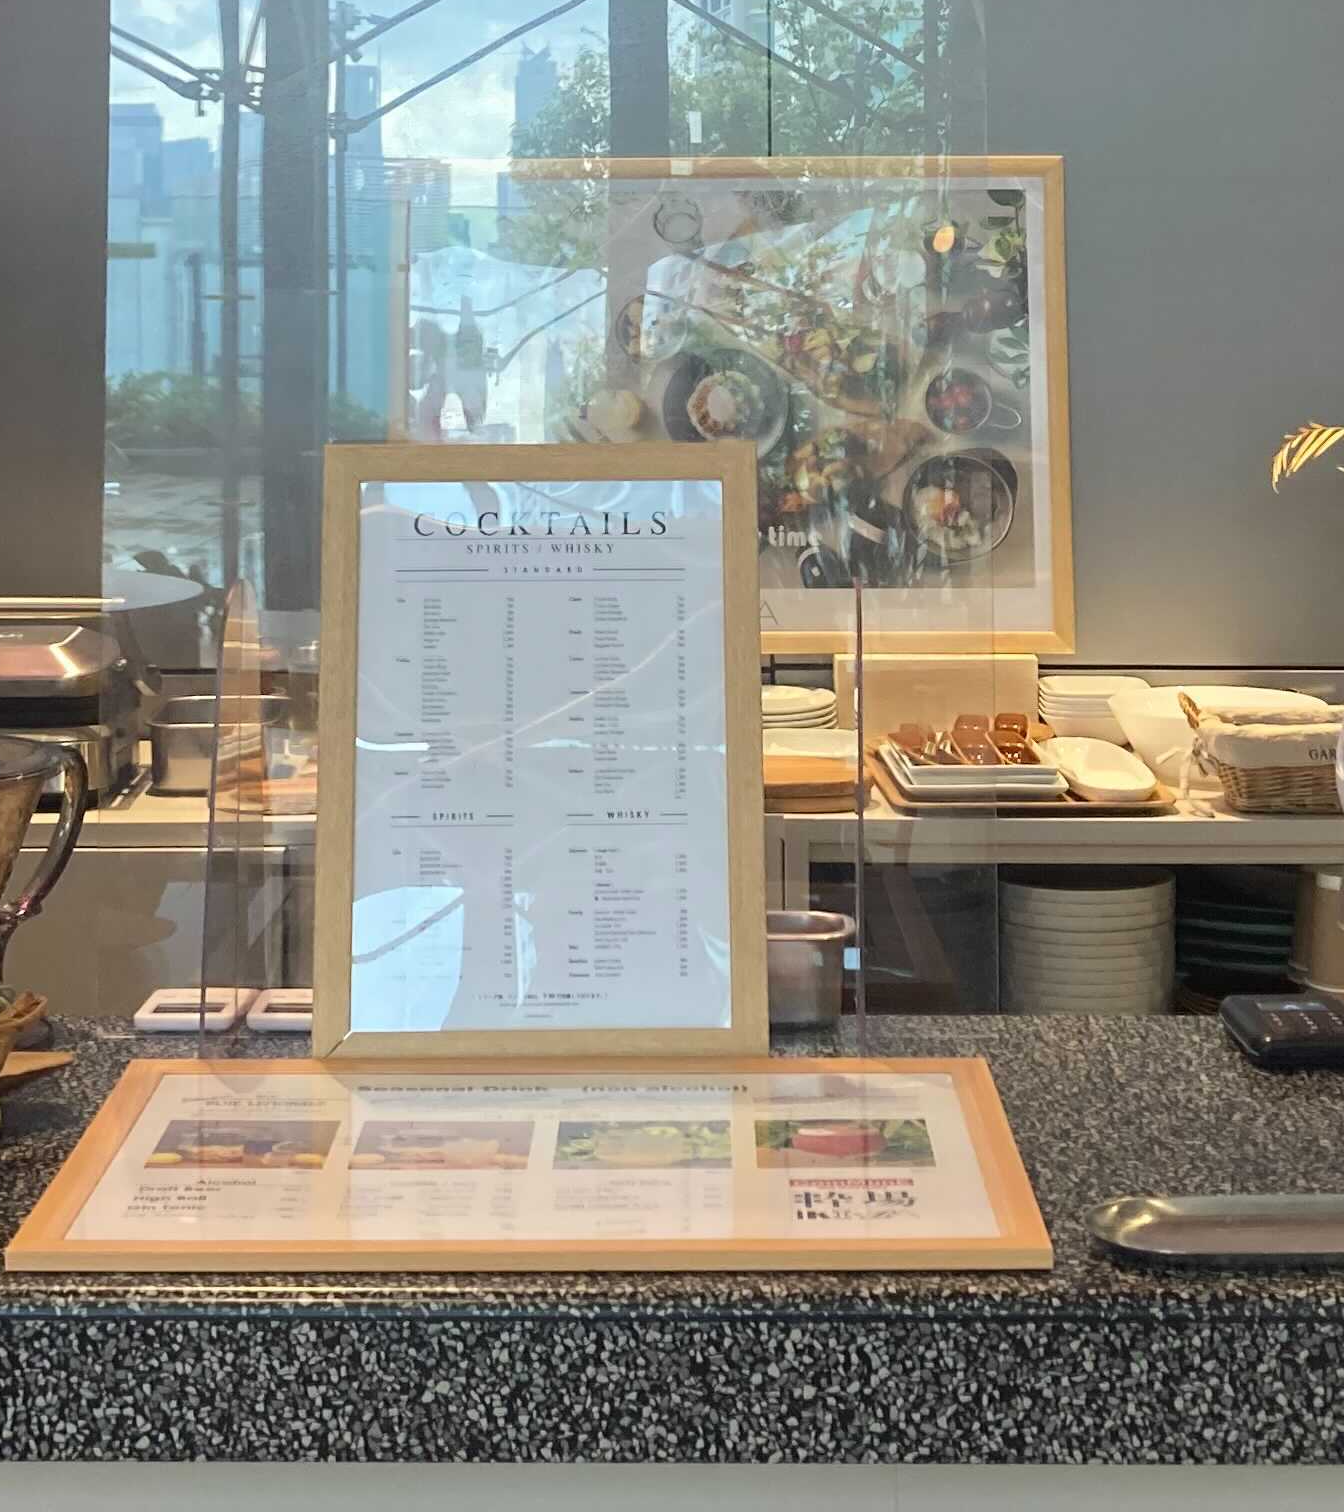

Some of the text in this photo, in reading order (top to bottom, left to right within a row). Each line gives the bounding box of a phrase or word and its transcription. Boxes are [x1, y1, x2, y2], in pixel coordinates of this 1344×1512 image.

[414, 512, 667, 536] COCKTAILS
[467, 544, 615, 553] SPIRITS WHISKY
[1309, 749, 1336, 760] GAR
